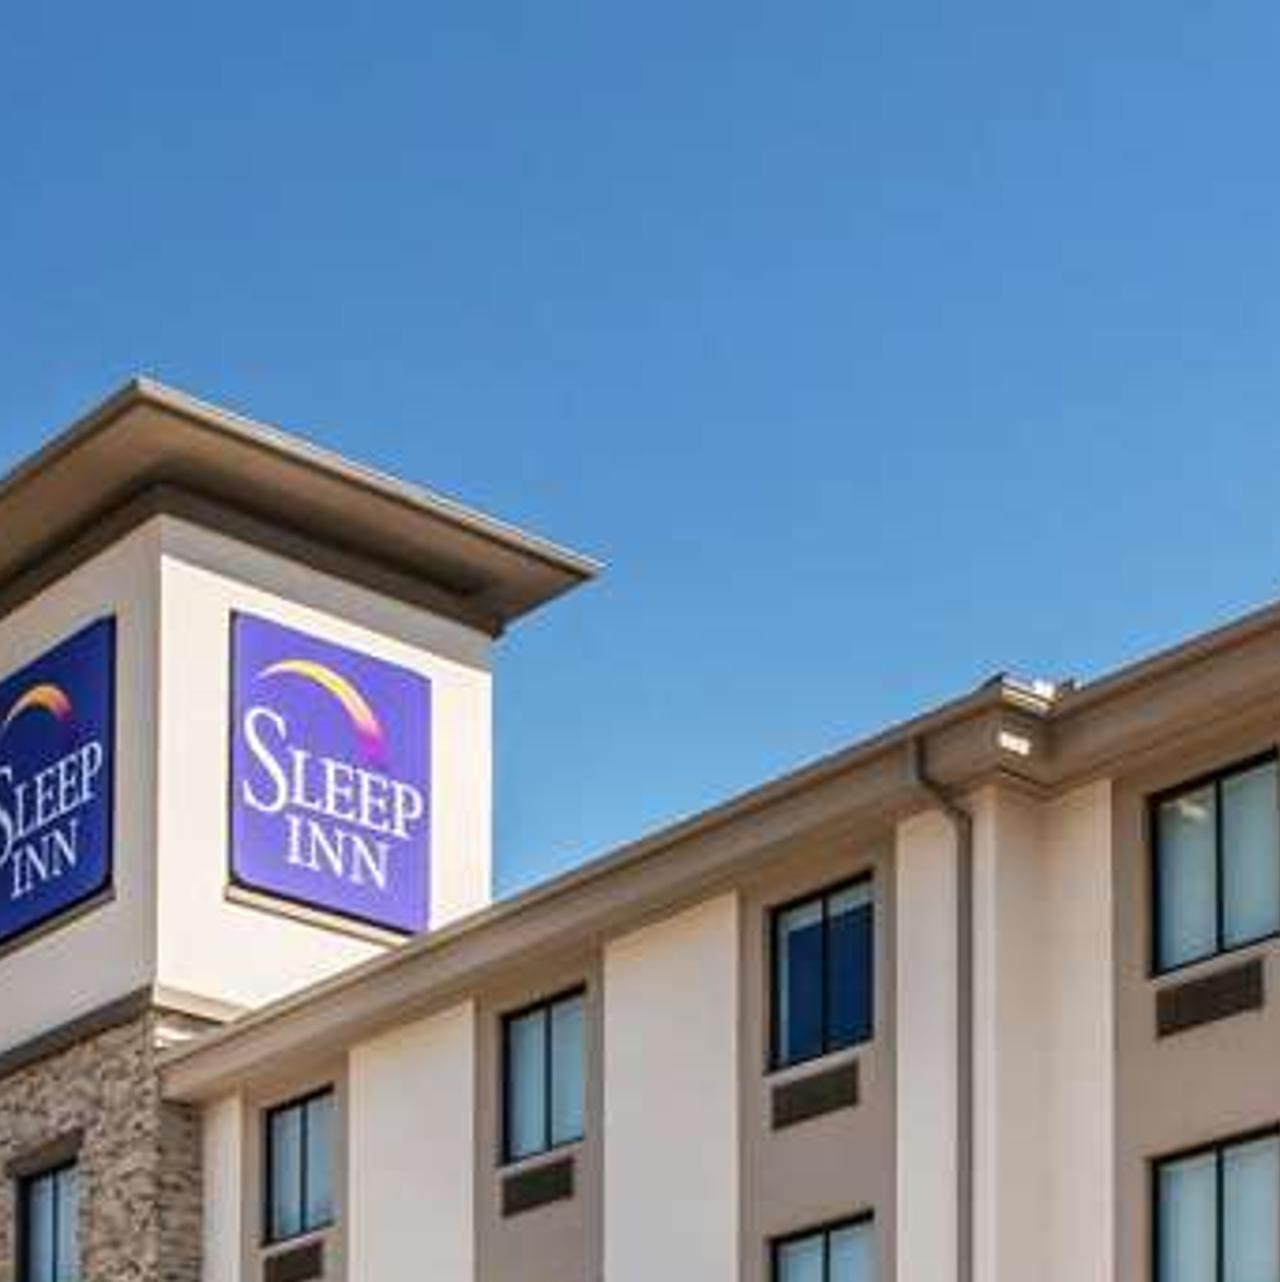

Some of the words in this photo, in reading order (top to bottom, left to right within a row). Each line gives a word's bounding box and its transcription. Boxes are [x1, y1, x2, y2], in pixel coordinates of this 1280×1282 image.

[243, 706, 424, 841] SLEEP
[11, 818, 78, 899] INN
[285, 813, 393, 889] INN
